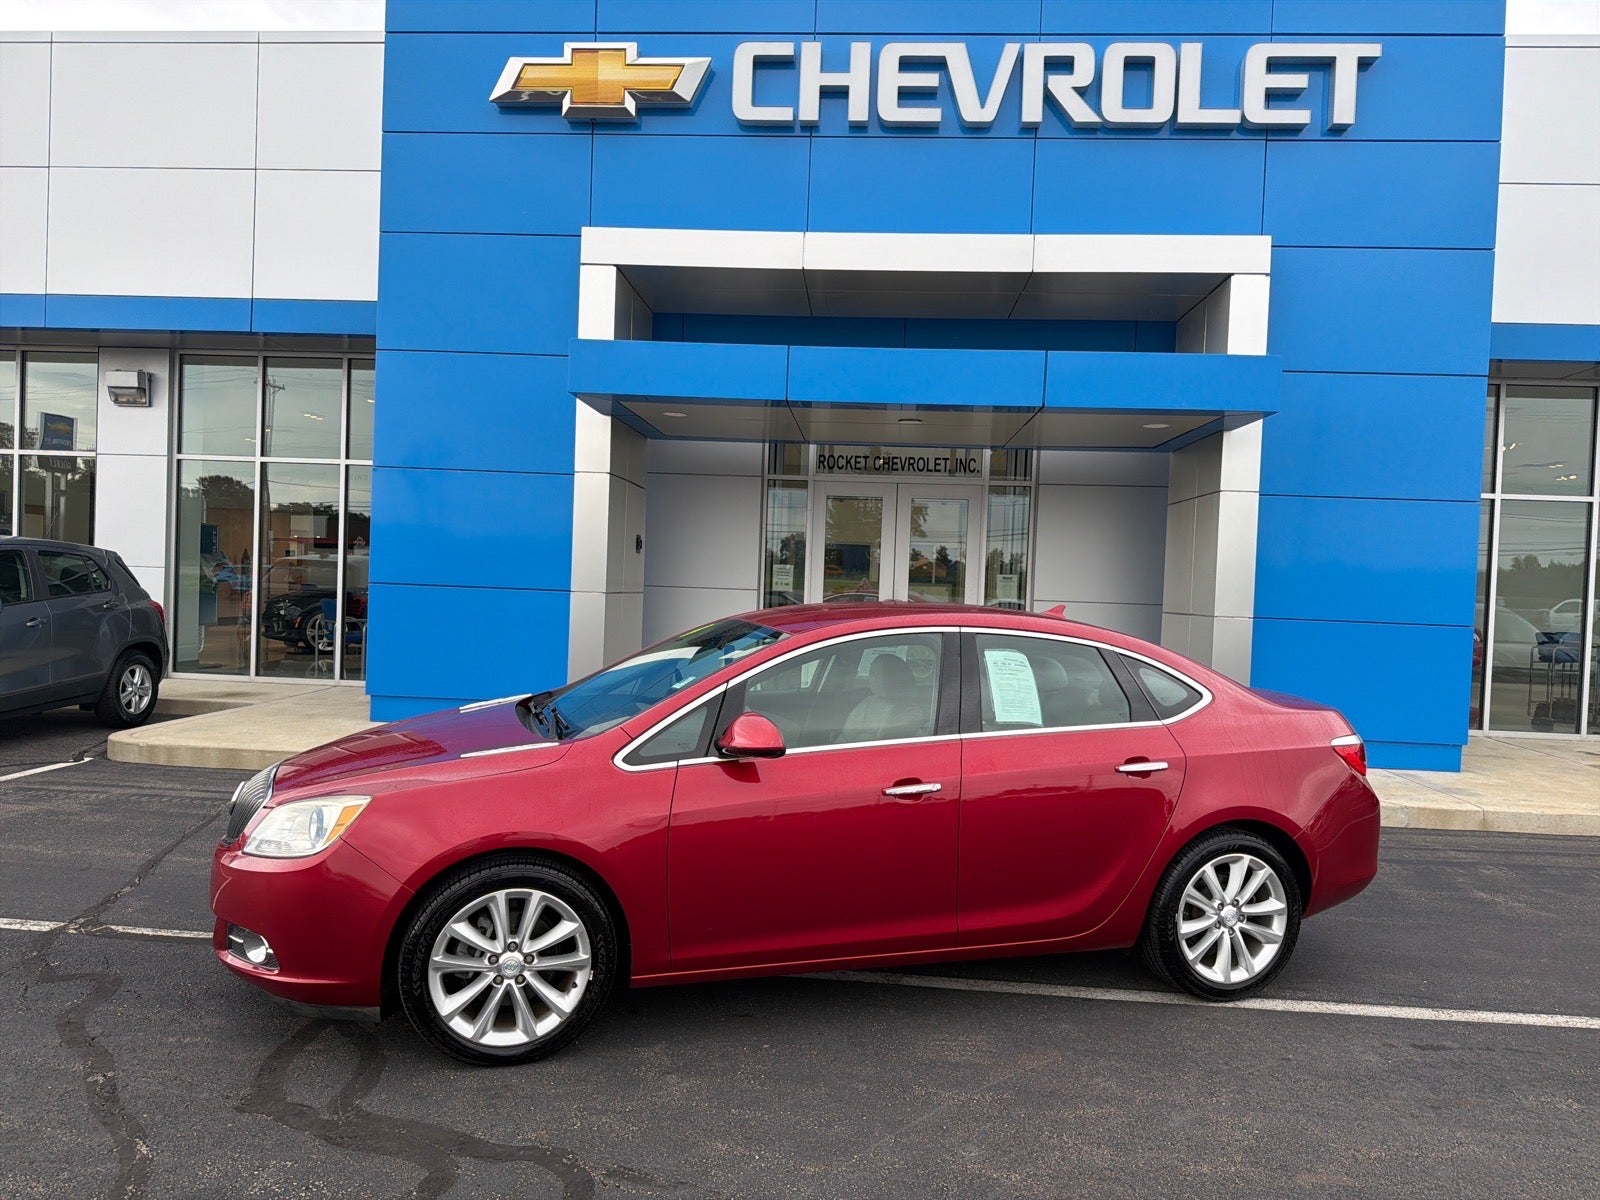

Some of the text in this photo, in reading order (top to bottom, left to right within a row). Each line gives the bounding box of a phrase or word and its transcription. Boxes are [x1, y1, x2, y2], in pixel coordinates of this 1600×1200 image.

[732, 41, 1382, 128] CHEVROLET
[818, 454, 870, 471] ROCKET
[955, 457, 980, 474] INC.
